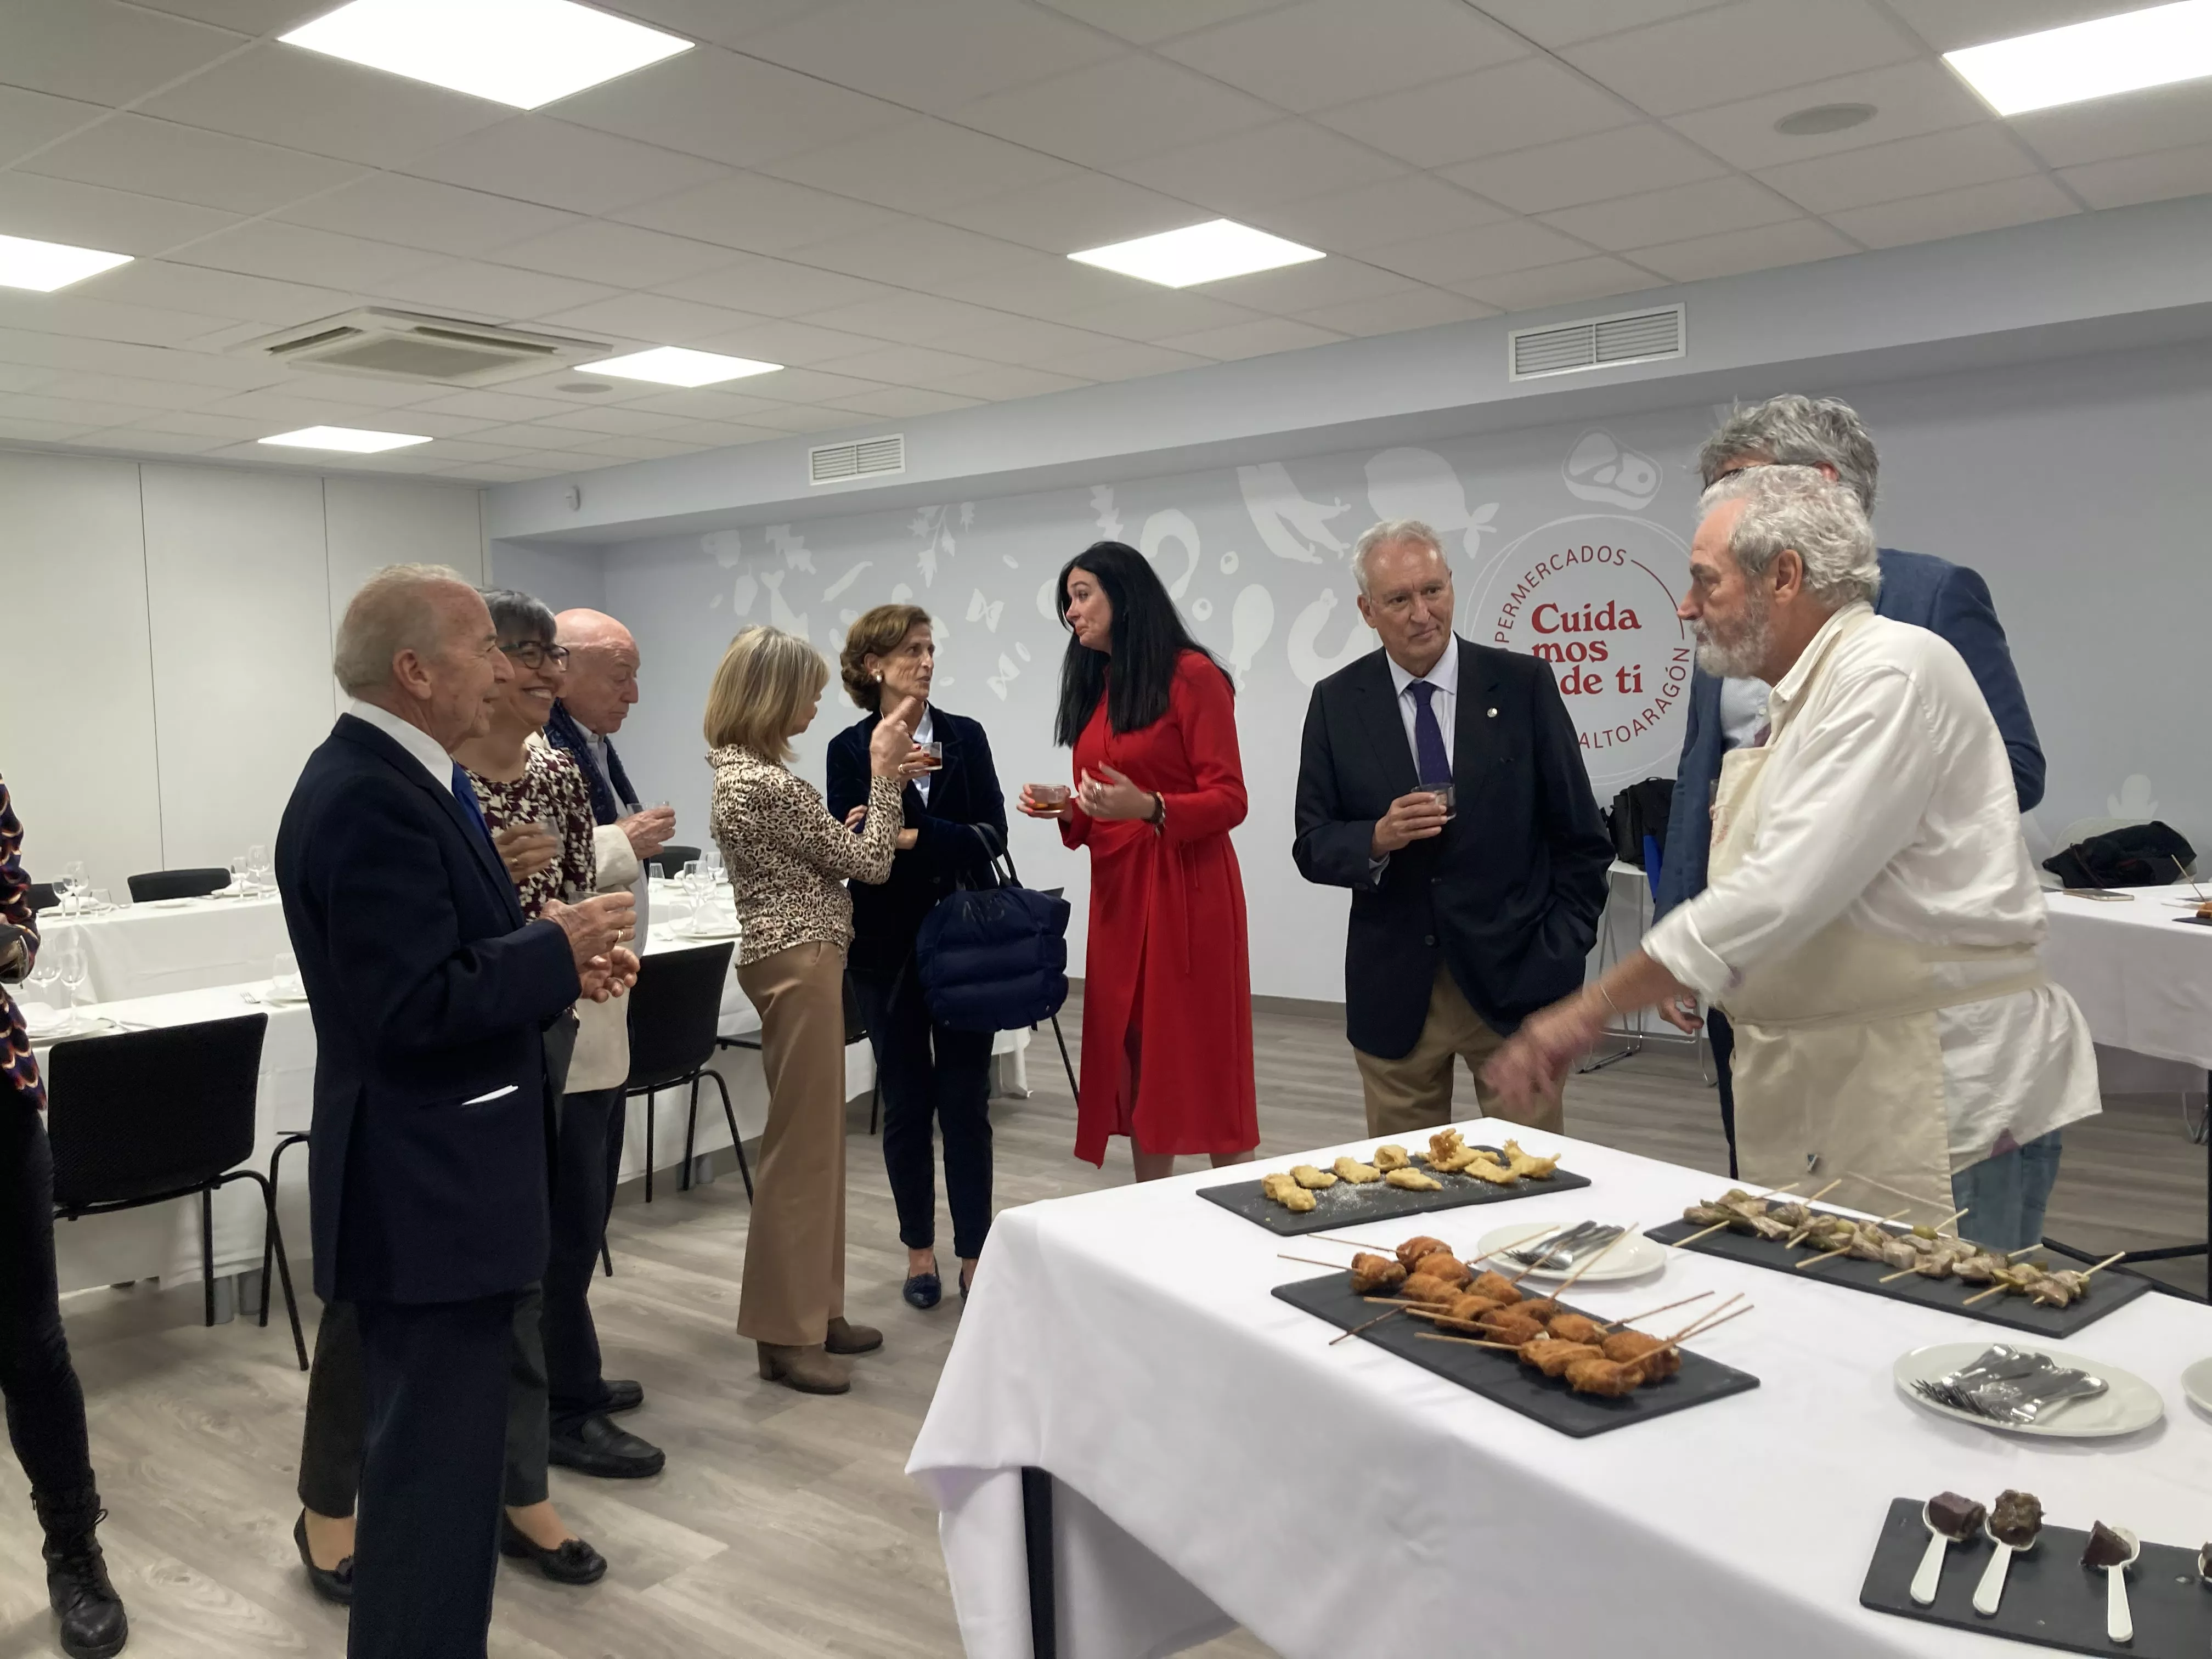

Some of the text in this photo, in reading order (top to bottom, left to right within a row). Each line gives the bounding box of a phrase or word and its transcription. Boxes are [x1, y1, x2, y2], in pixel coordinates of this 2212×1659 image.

[1494, 545, 1627, 651] PERMERCADOS
[1531, 600, 1642, 634] Cuida
[1531, 640, 1608, 663] mos
[1560, 664, 1643, 695] de ti
[1578, 647, 1690, 749] ALTOARAGÓN
